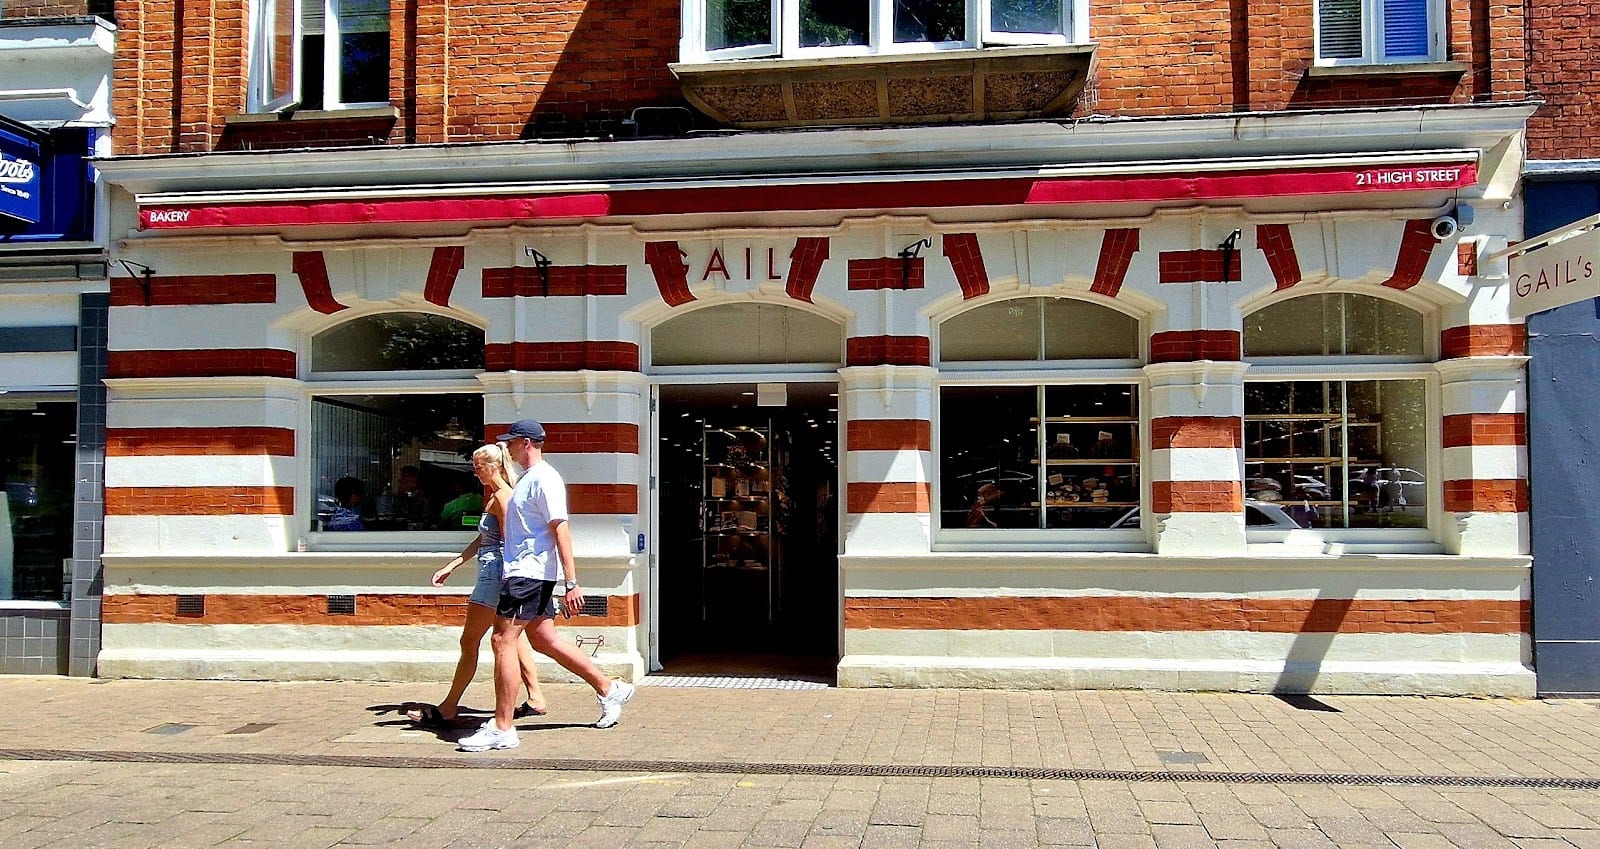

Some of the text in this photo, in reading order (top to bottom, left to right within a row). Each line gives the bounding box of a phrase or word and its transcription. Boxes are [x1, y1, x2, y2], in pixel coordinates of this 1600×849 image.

[0, 149, 34, 182] oots
[1355, 169, 1461, 185] 21 HIGH STREET
[150, 211, 190, 222] BAKERY
